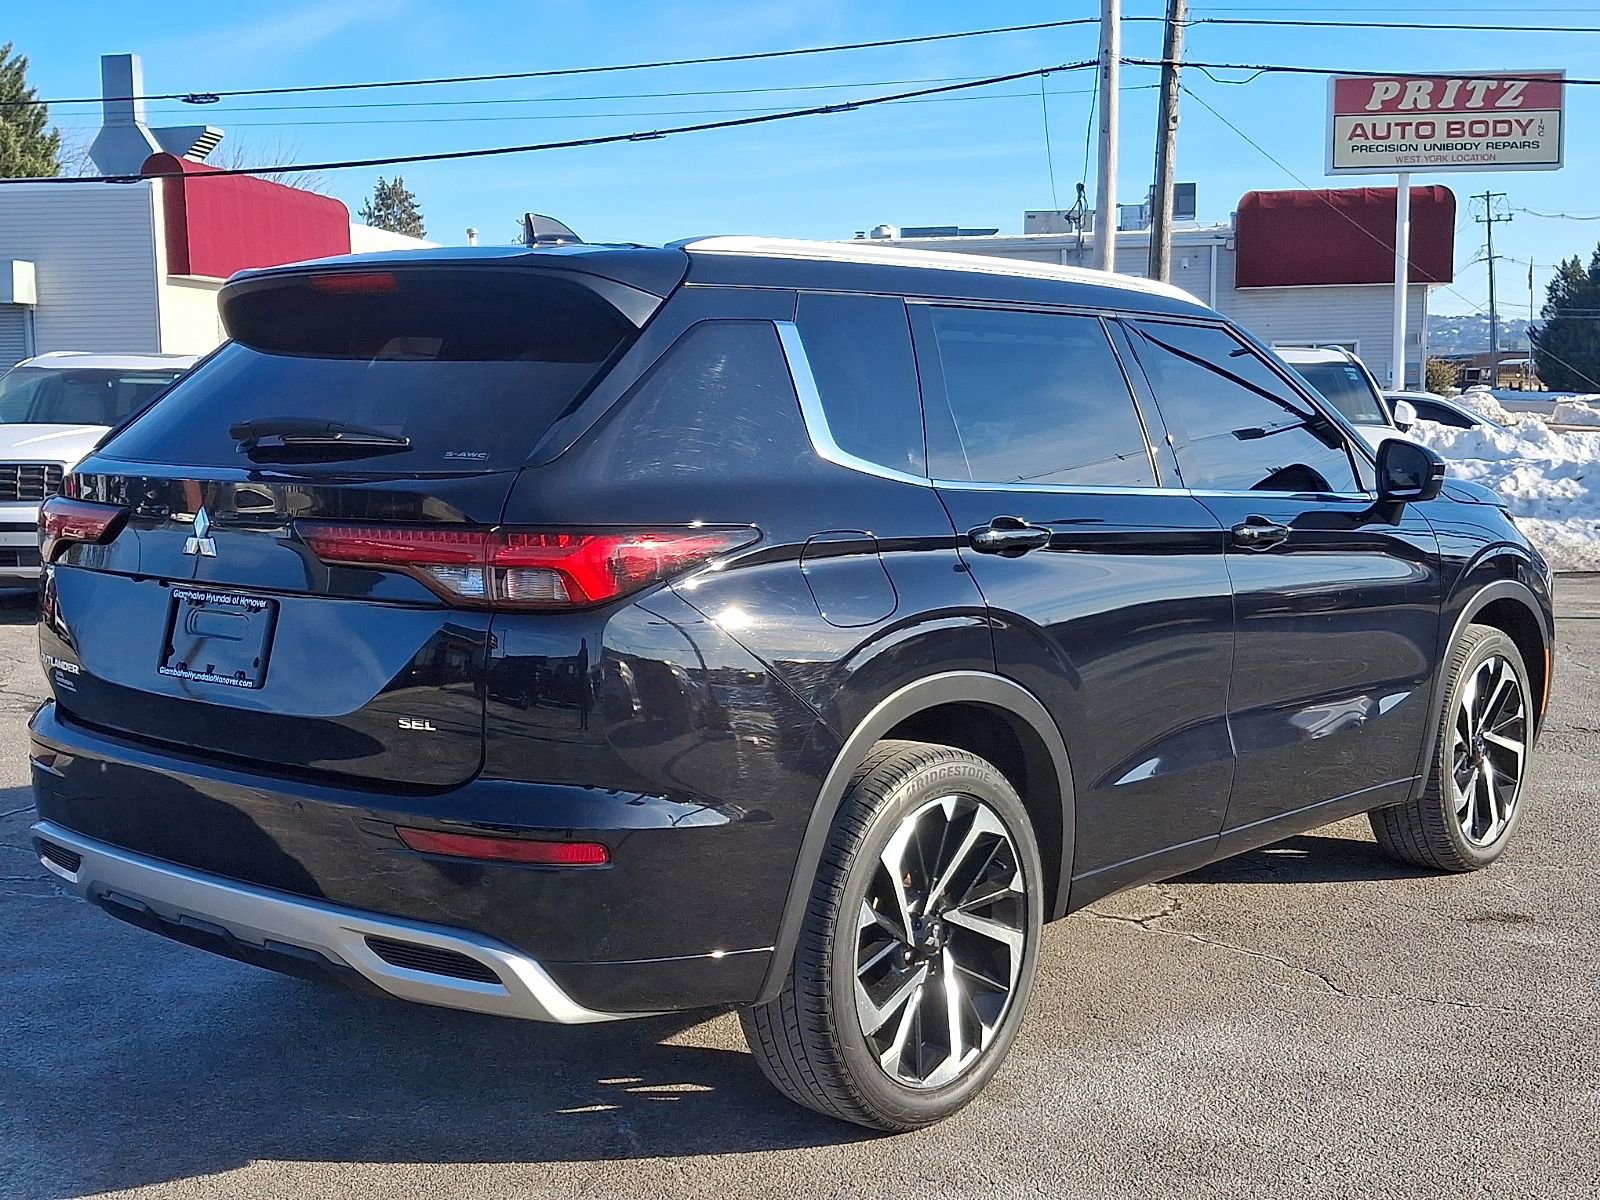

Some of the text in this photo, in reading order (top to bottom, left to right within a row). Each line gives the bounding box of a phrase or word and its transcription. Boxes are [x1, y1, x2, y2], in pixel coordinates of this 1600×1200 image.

[1364, 79, 1529, 111] PRITZ
[1347, 118, 1535, 140] AUTO BODY
[1351, 140, 1540, 153] PRECISION UNIBODY REPAIRS
[1424, 155, 1448, 163] YORK
[1451, 153, 1496, 162] LOCATION
[173, 590, 205, 601] Giambalvo
[206, 592, 231, 604] Hyundai
[241, 598, 267, 608] Hanover
[398, 717, 436, 731] SEL
